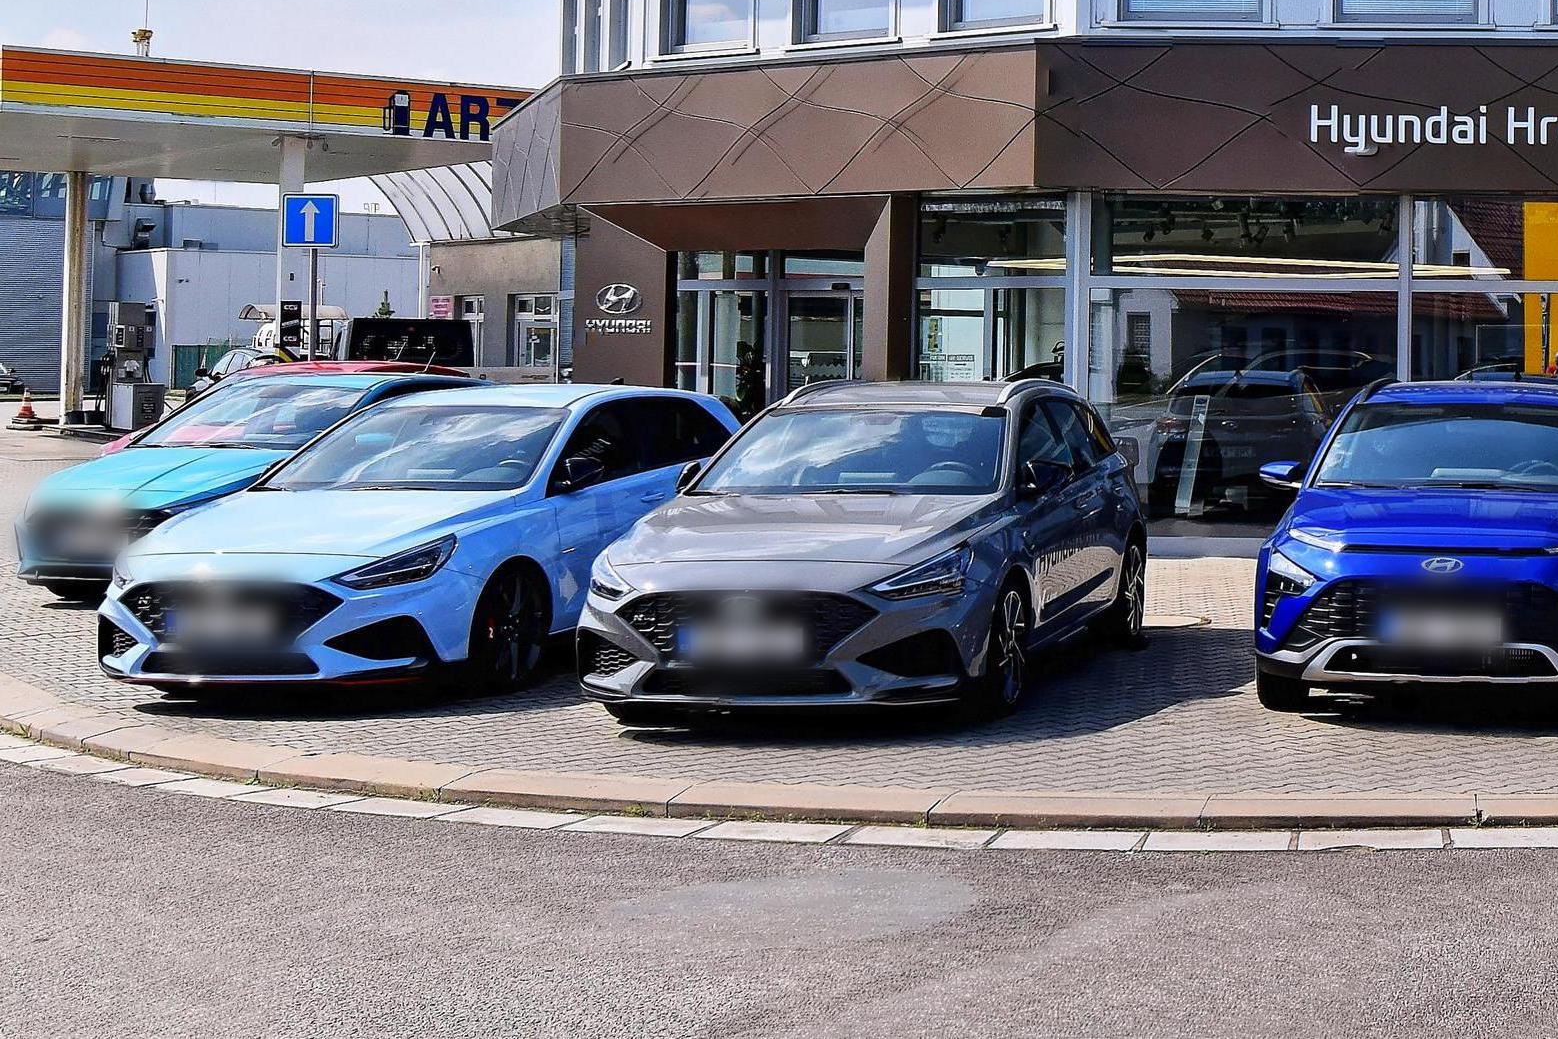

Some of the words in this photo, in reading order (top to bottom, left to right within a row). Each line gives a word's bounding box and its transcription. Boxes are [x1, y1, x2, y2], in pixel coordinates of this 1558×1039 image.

[423, 93, 526, 141] AR
[1309, 104, 1488, 153] Hyundai
[585, 319, 651, 333] HYUNDAI
